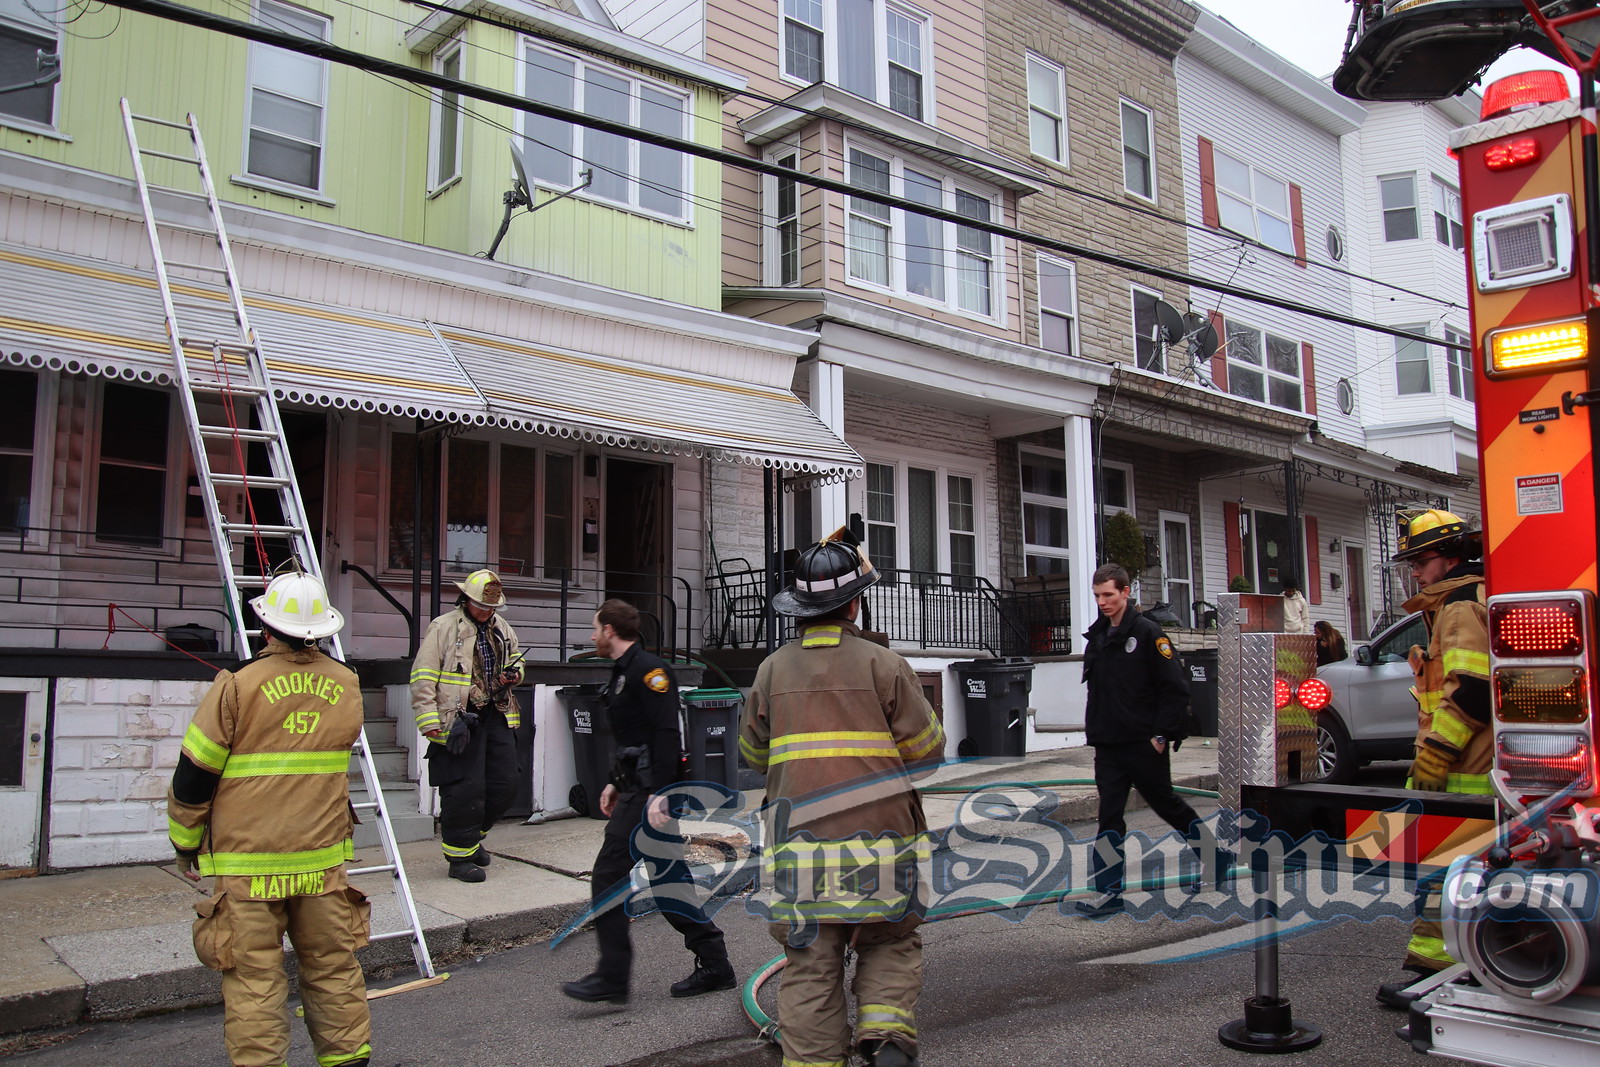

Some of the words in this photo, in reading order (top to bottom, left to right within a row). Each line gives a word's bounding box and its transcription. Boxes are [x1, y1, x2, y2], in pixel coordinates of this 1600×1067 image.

[261, 672, 345, 705] HOOKIES
[282, 711, 321, 734] 457
[573, 709, 590, 717] County
[250, 870, 326, 899] MATUNIS
